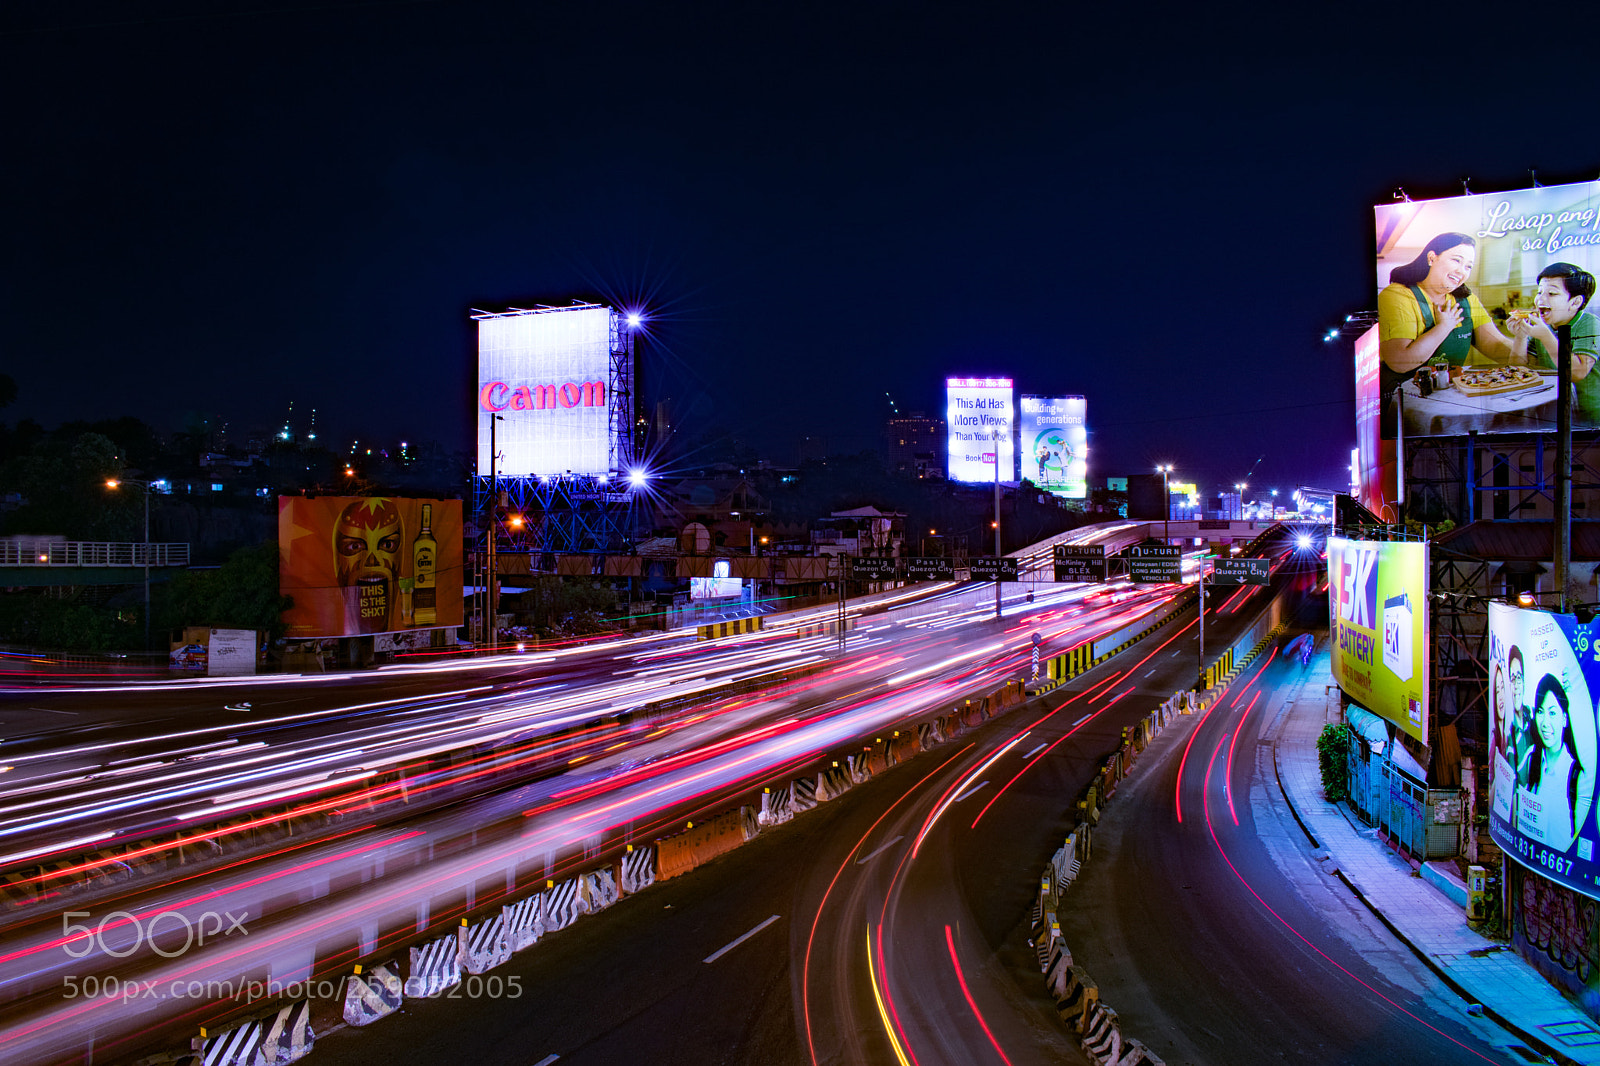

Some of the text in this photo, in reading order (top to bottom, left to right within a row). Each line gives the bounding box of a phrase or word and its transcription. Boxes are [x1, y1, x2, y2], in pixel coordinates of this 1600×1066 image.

[1477, 201, 1554, 238] Lasap
[1557, 208, 1596, 227] ang
[1522, 237, 1546, 251] sa
[480, 381, 605, 412] Canon
[956, 398, 1005, 409] This Ad Has
[1025, 403, 1056, 415] Building
[954, 415, 1007, 426] More Views
[1036, 415, 1082, 426] generations
[955, 432, 972, 441] Than
[974, 432, 989, 441] Your
[965, 454, 982, 462] Book
[978, 559, 1009, 567] Pasig
[1055, 559, 1087, 568] McKinley
[1226, 561, 1257, 569] Pasig
[881, 565, 895, 574] City
[938, 565, 954, 574] City
[1001, 566, 1017, 575] City
[1215, 568, 1268, 578] Quezon City
[361, 585, 384, 596] THIS
[1340, 549, 1378, 631] 3K
[360, 596, 386, 607] IS THE
[361, 607, 385, 618] SHXT
[1530, 622, 1554, 636] PASSED
[1339, 623, 1375, 666] BATTERY
[1540, 640, 1549, 650] UP
[1535, 649, 1558, 663] ATENEO
[1518, 837, 1574, 877] 831-6667
